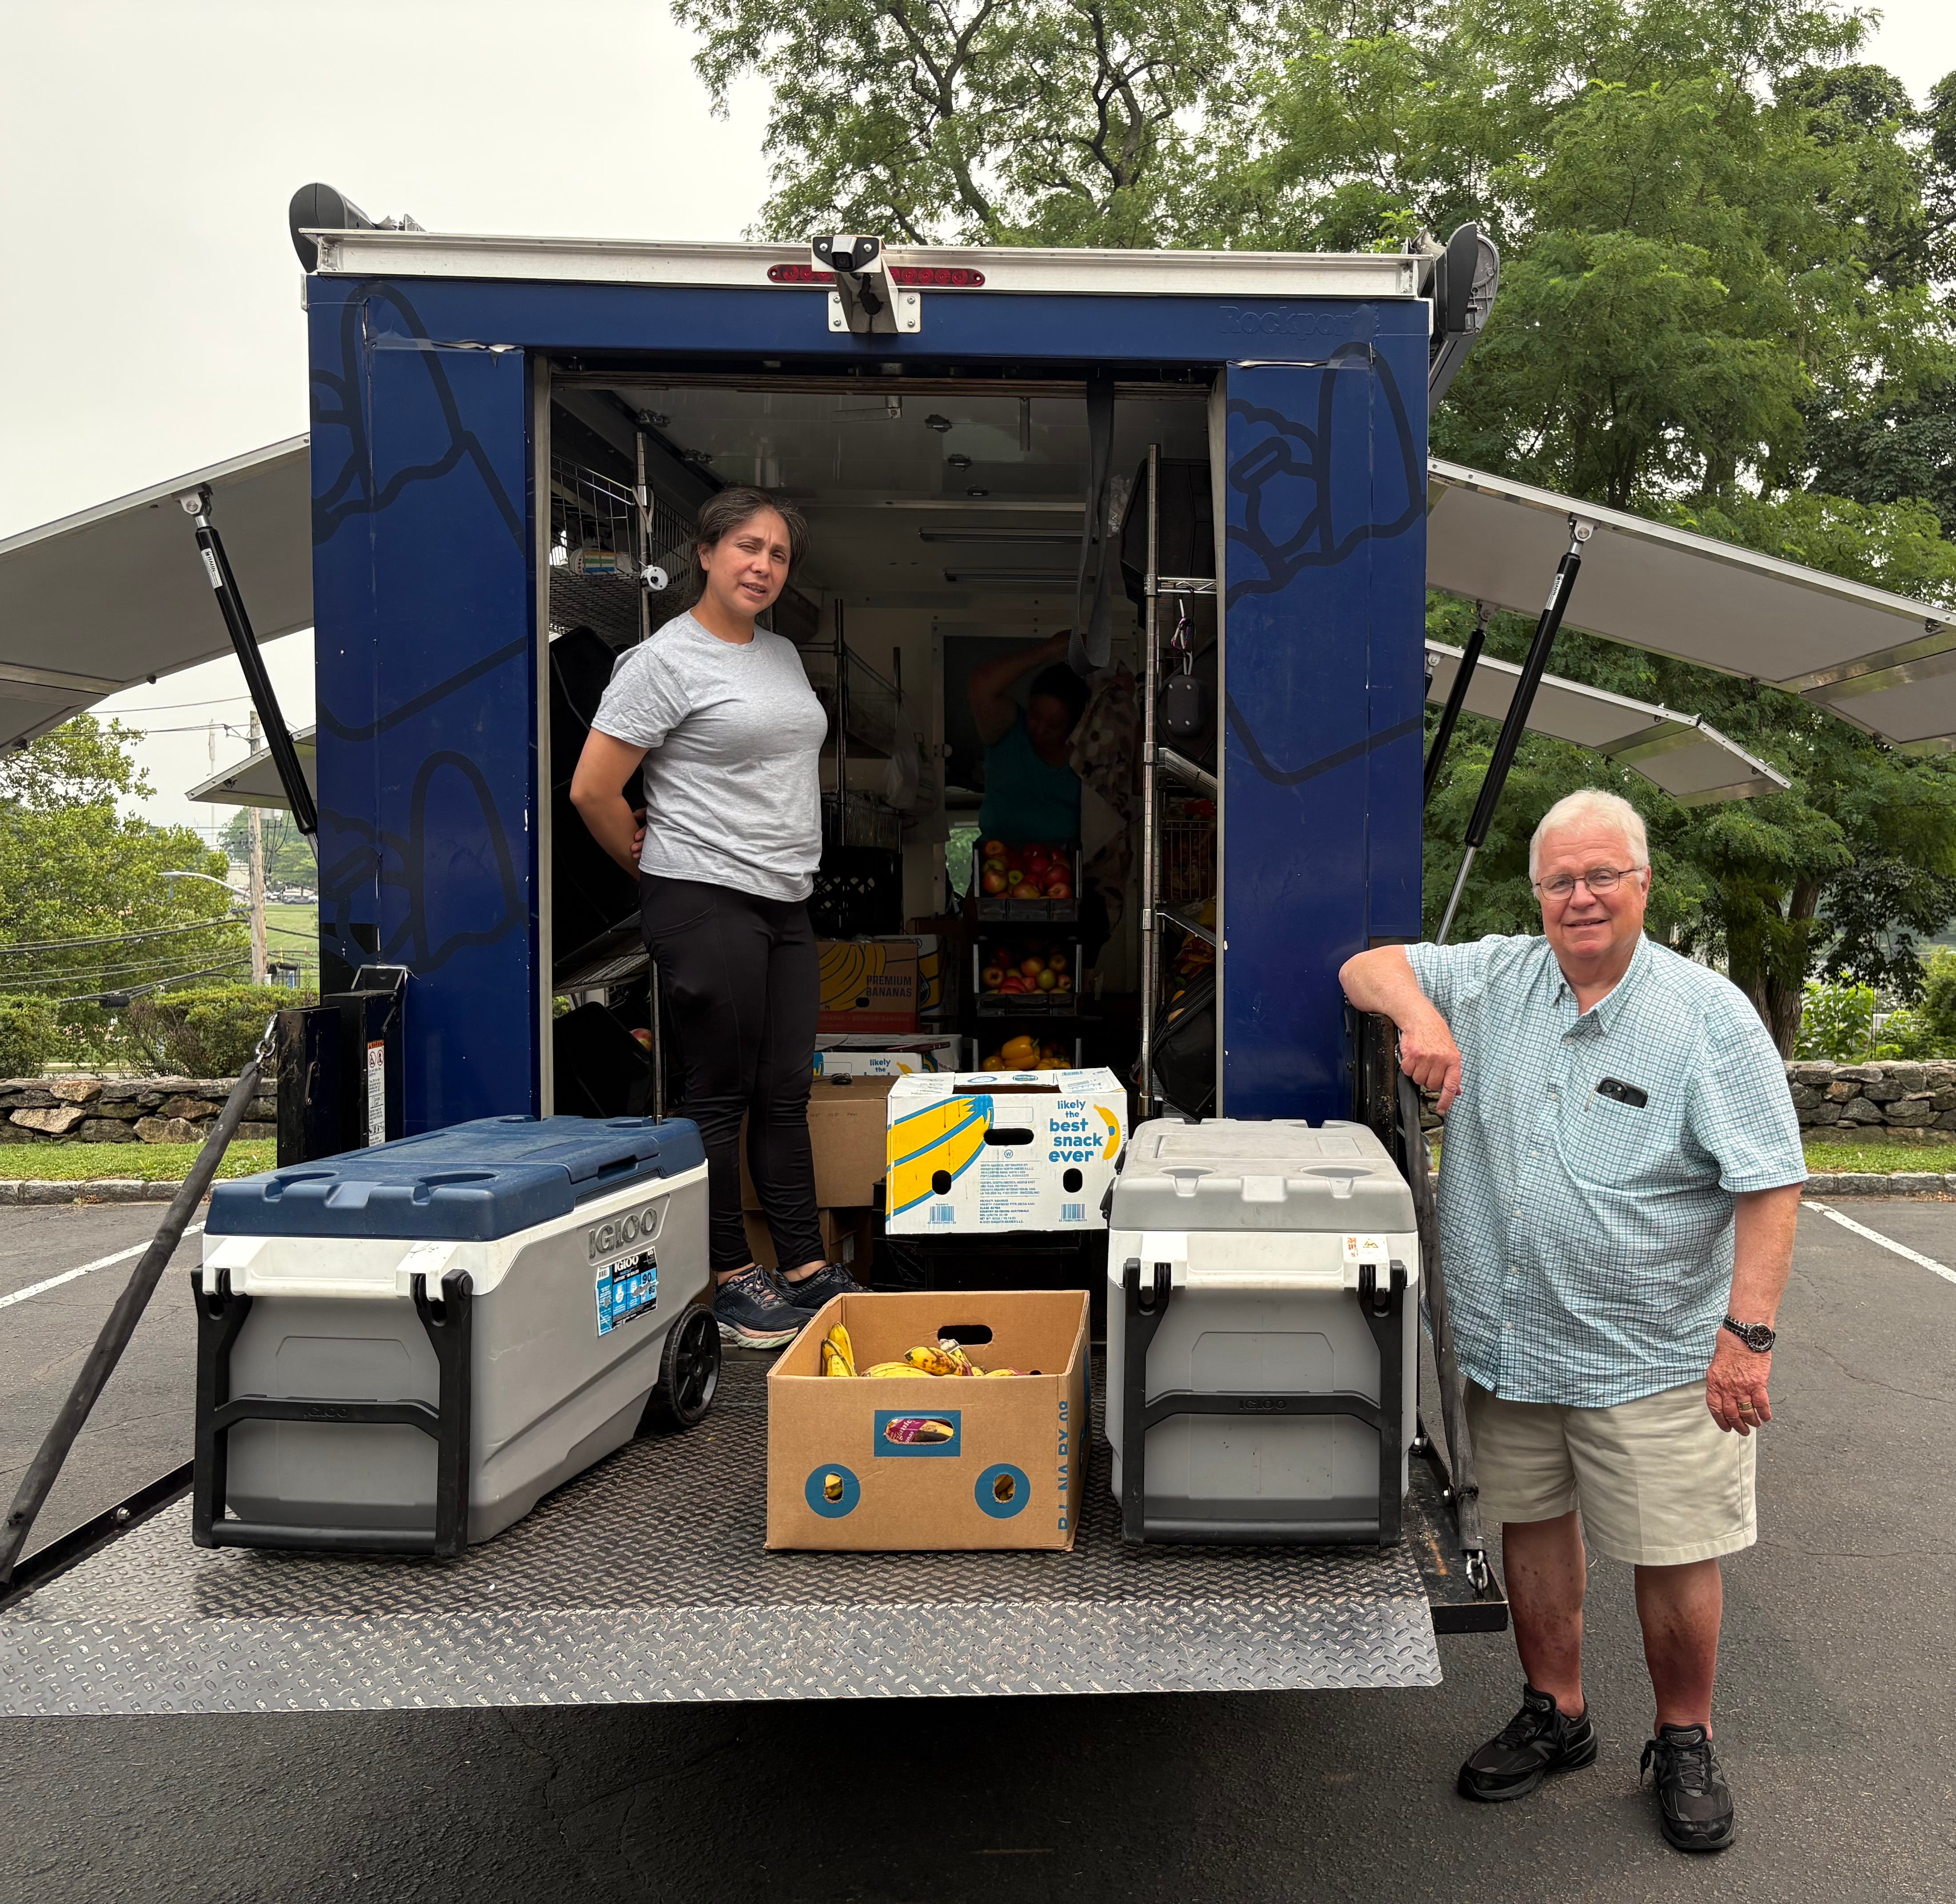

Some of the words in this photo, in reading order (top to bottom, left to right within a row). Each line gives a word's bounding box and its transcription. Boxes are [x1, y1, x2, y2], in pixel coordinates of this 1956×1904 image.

[867, 976, 911, 985] PREMIUM
[867, 987, 912, 996] BANANAS
[870, 1058, 891, 1067] likely
[1058, 1099, 1086, 1110] likely
[1050, 1118, 1088, 1132] best
[1054, 1133, 1103, 1147] snack
[1049, 1151, 1094, 1162] ever
[589, 1208, 658, 1259] IGLOO
[615, 1255, 639, 1272] IGLOO
[643, 1272, 652, 1284] 90
[1239, 1399, 1287, 1410] IGLOO
